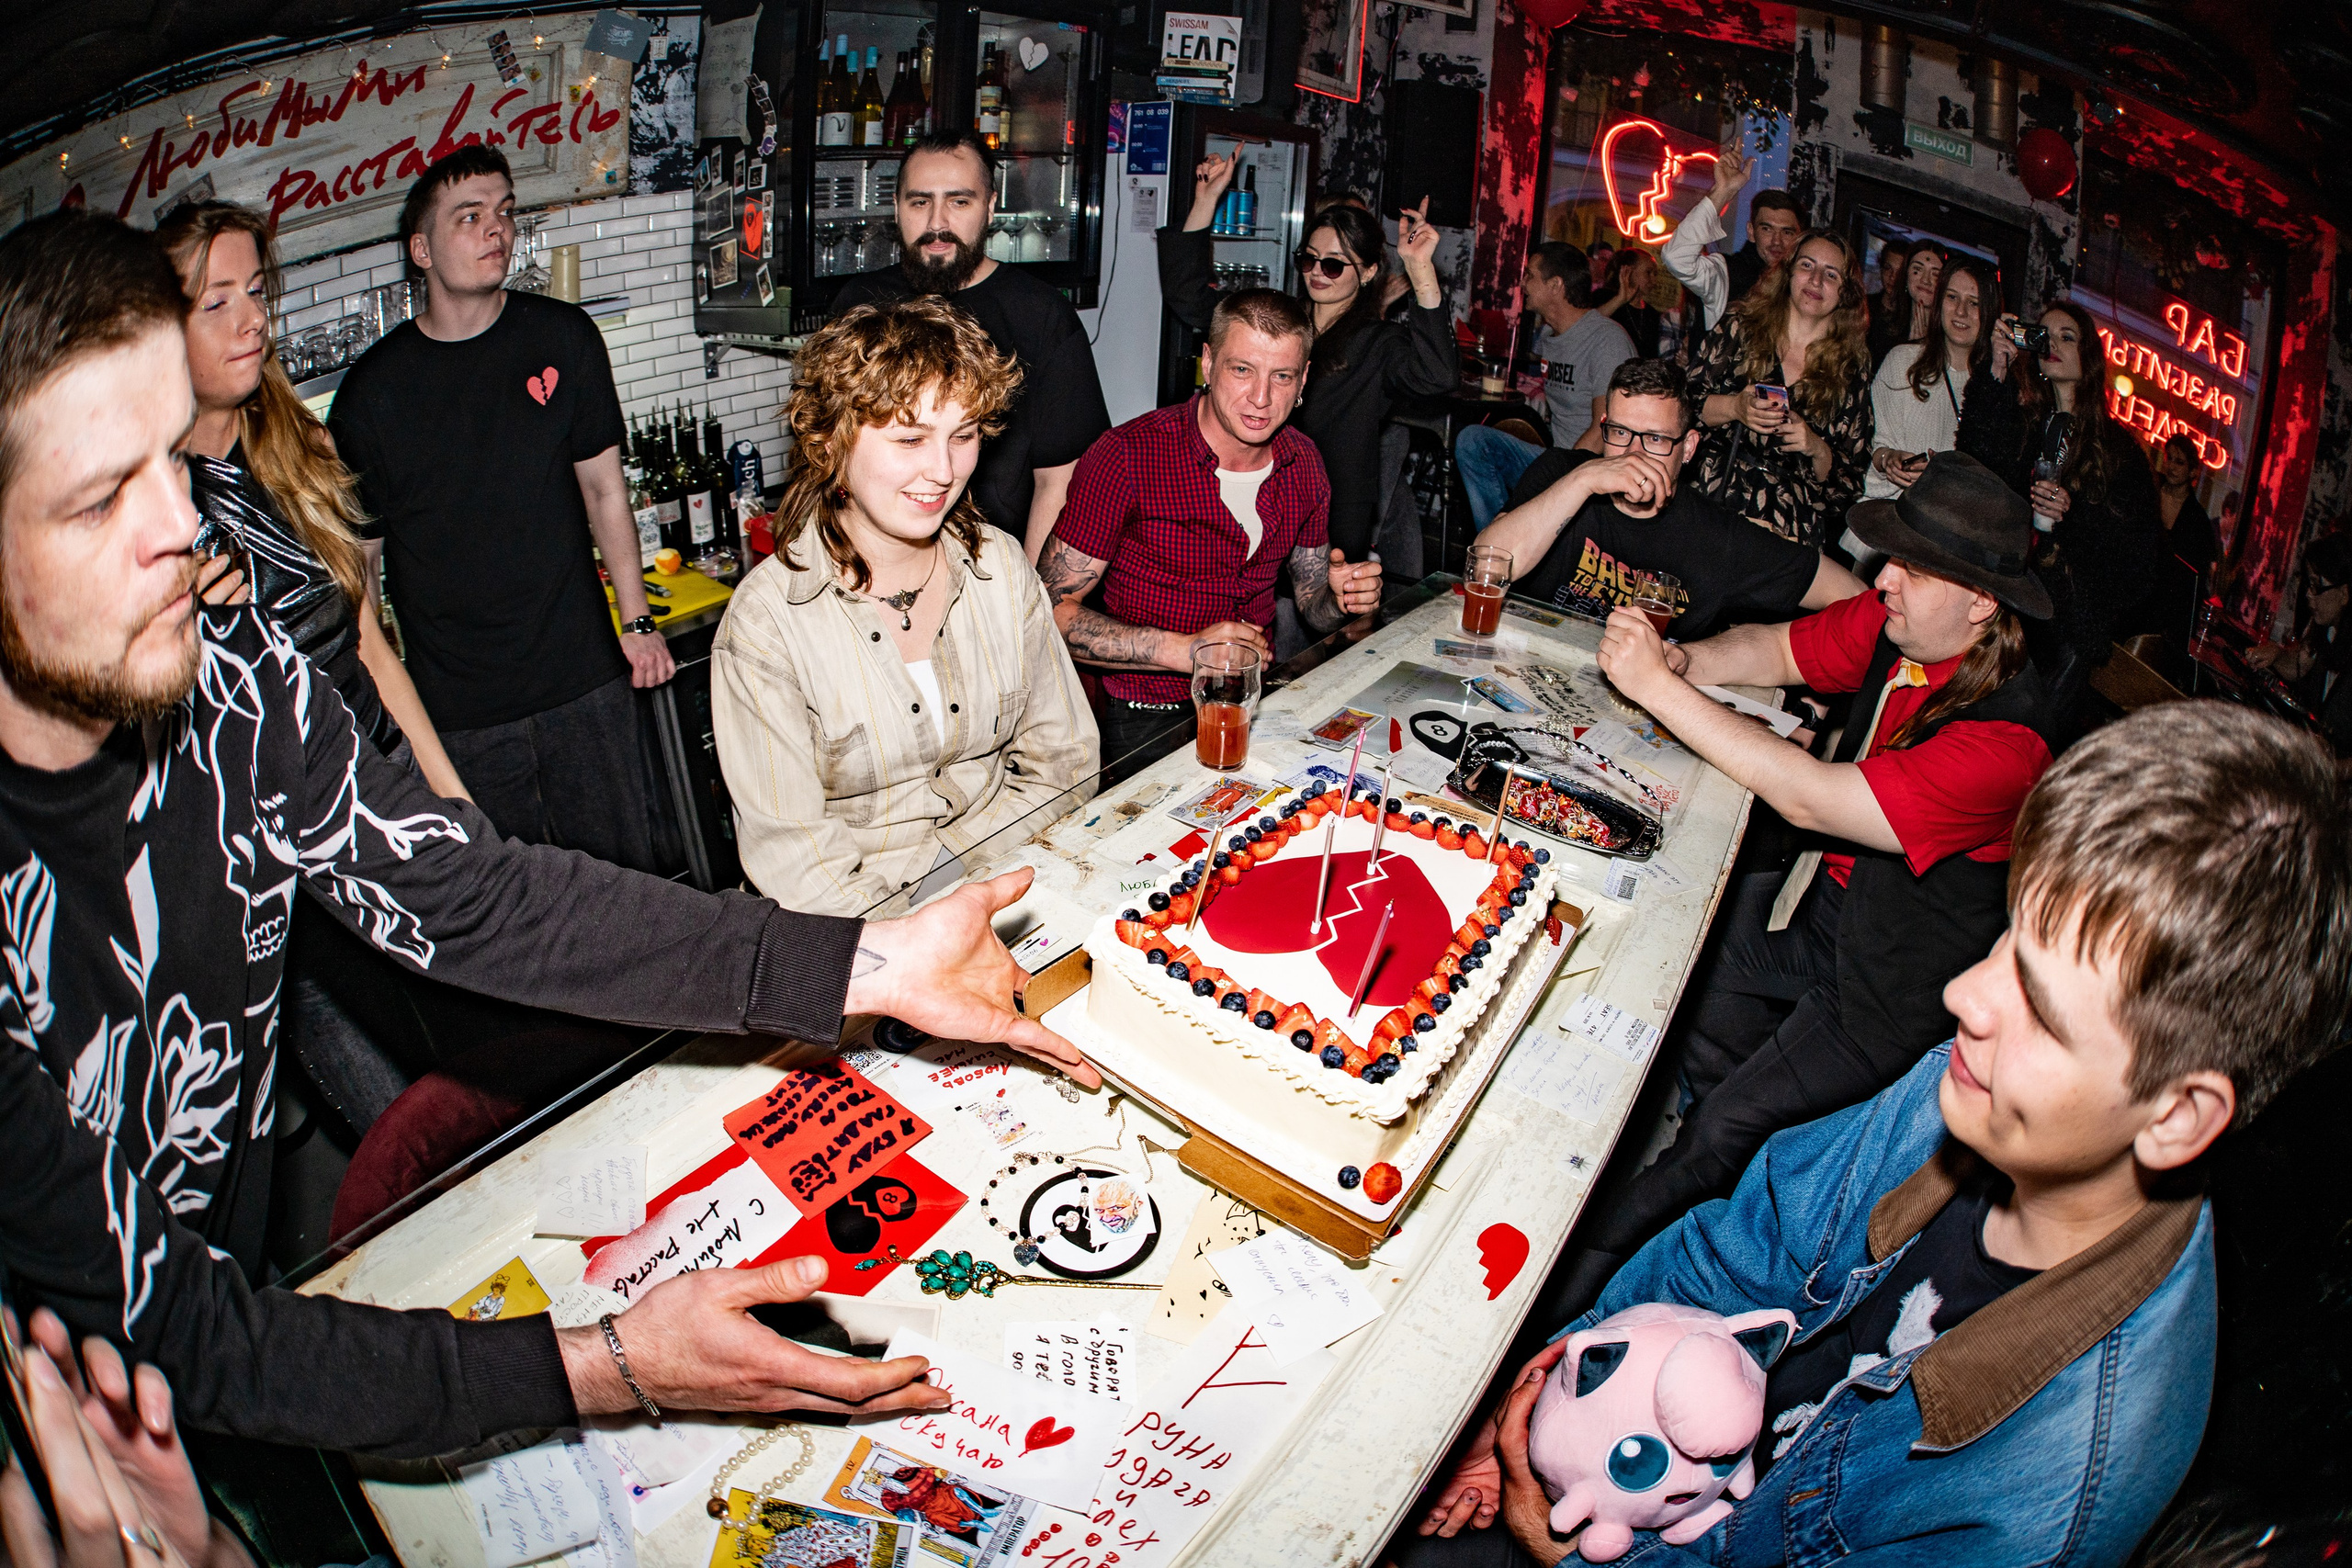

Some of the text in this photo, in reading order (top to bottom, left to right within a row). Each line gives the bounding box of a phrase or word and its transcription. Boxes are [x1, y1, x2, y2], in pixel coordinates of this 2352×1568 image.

[1169, 17, 1209, 29] SWISSAM
[1913, 130, 1967, 160] ВЫХОД
[1541, 361, 1575, 385] DIESEL
[1573, 569, 1594, 586] TO
[1568, 581, 1589, 597] THE
[1600, 1002, 1613, 1018] SEAT
[1586, 1024, 1598, 1036] 47E
[943, 1058, 1013, 1089] ЛЮБОВЬ
[1124, 1411, 1232, 1471] РУНА
[999, 1515, 1028, 1557] ИМПЕРАТОР
